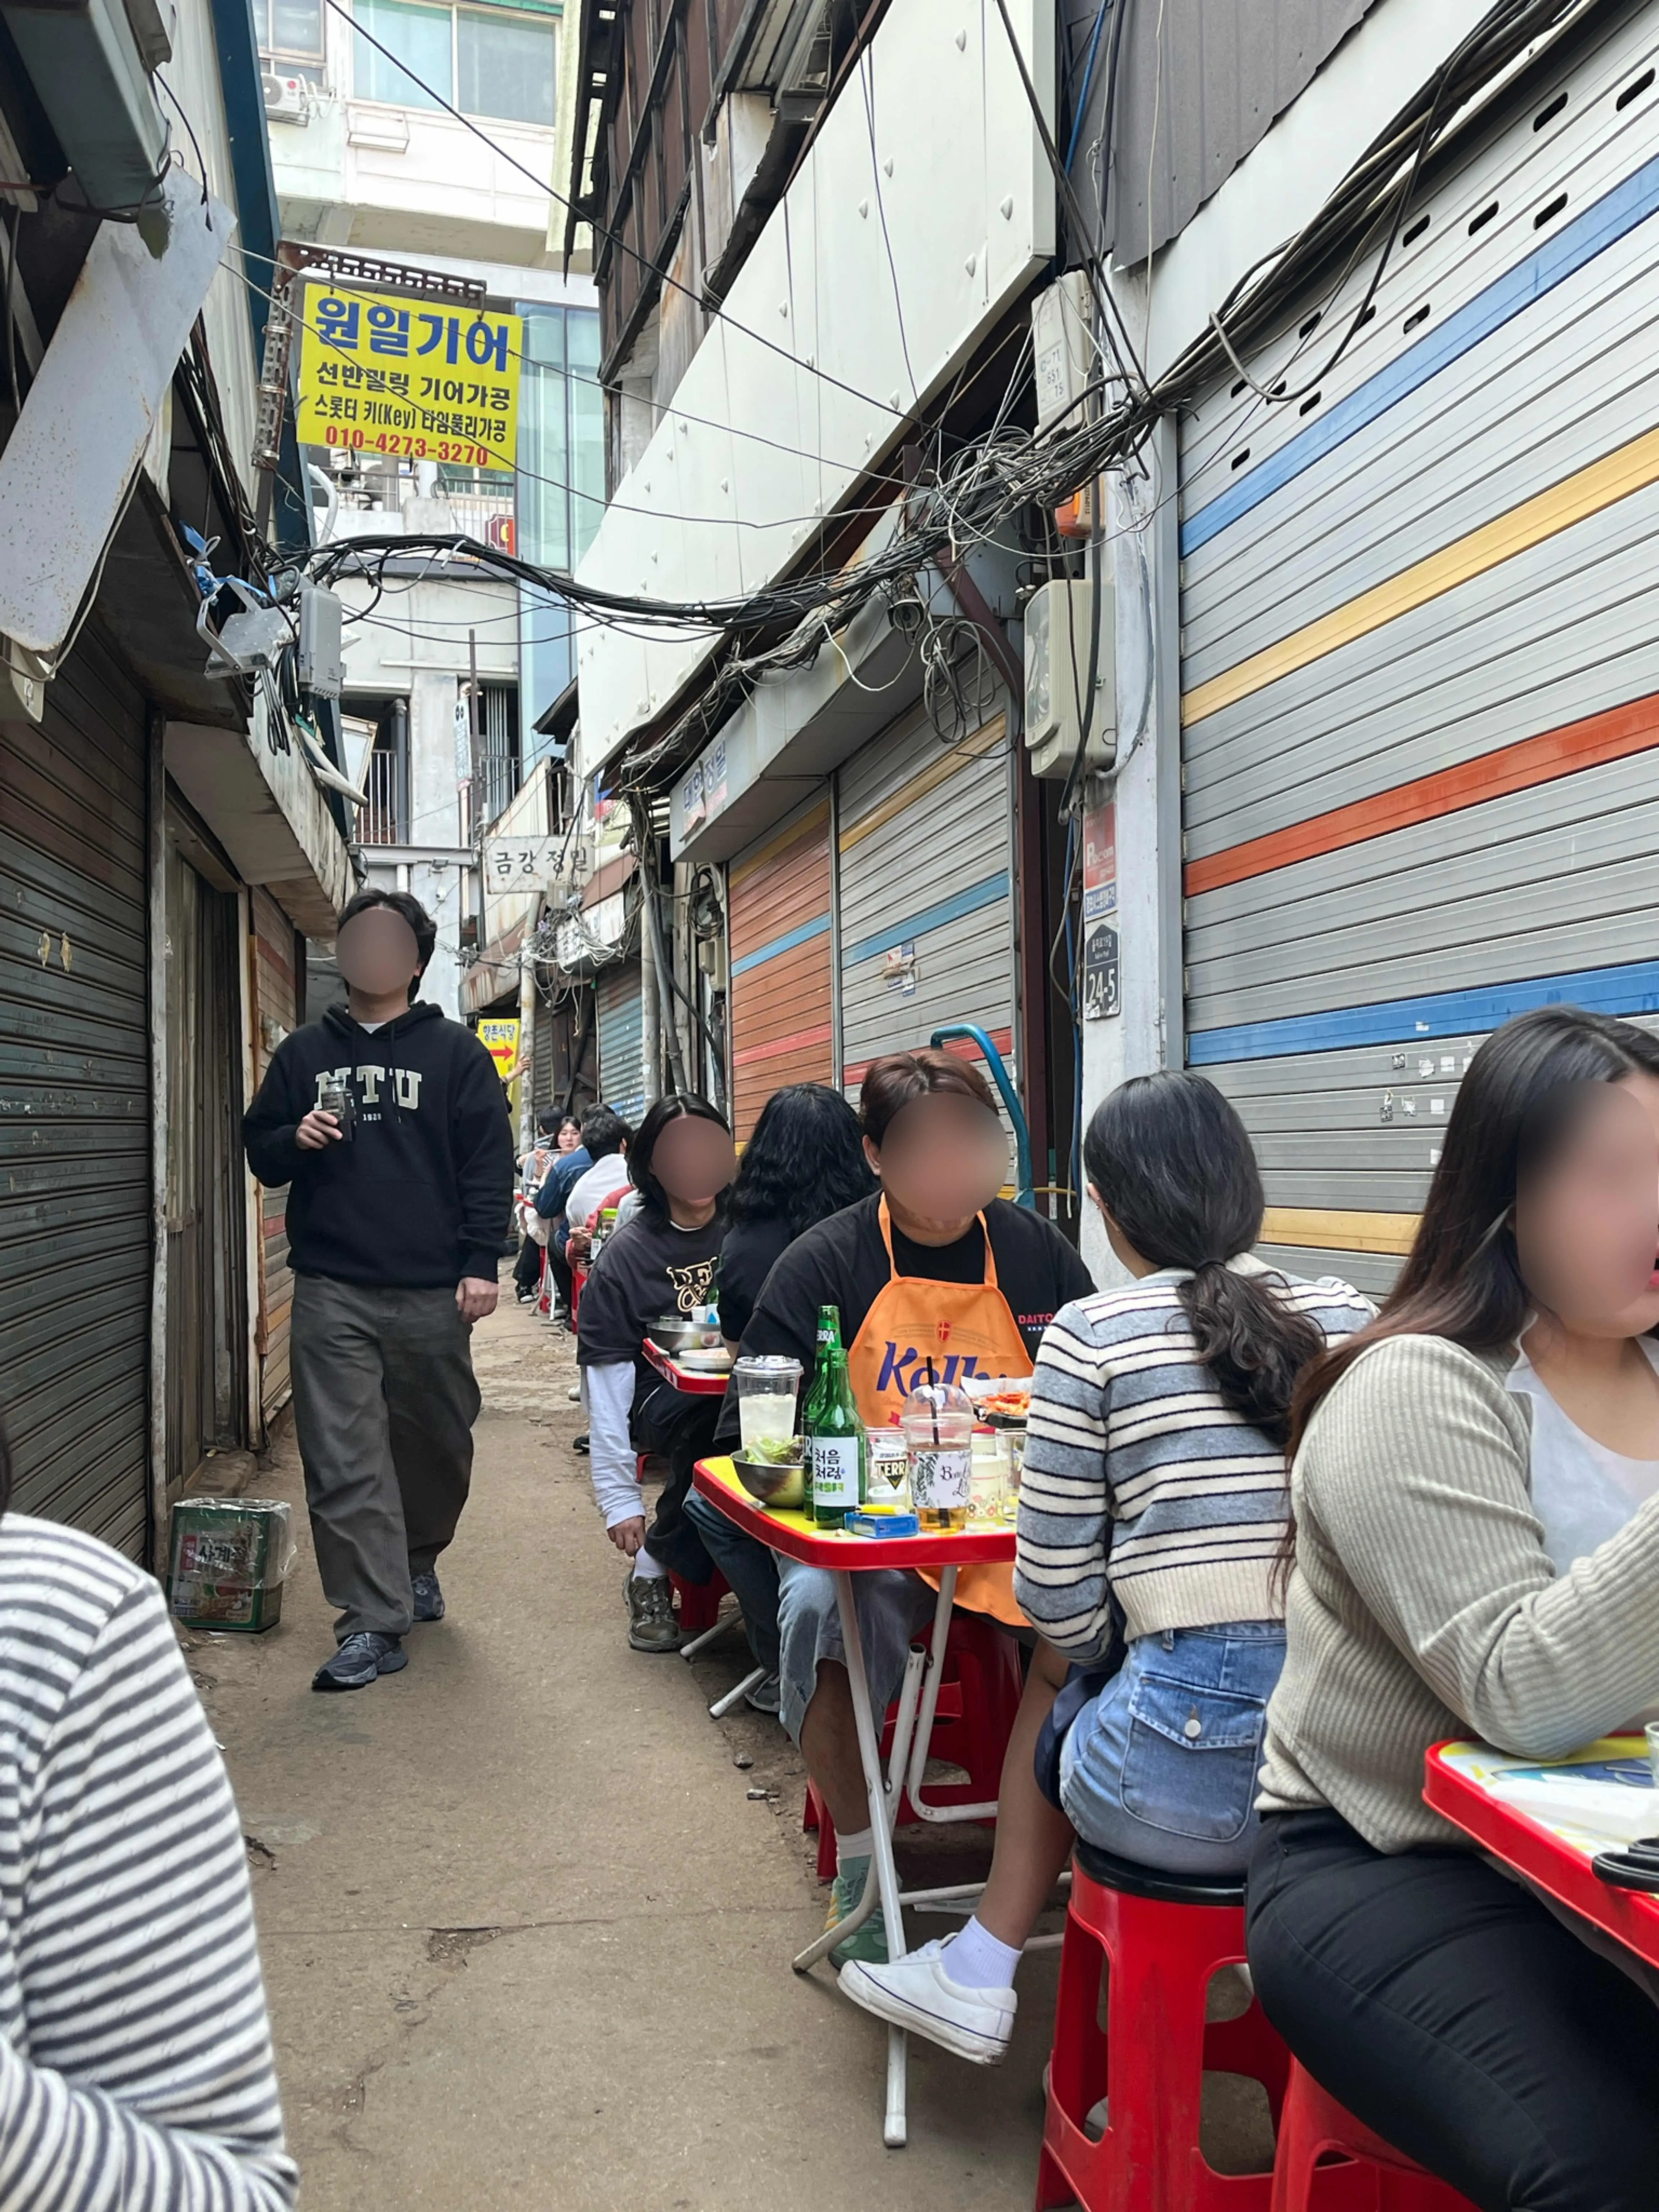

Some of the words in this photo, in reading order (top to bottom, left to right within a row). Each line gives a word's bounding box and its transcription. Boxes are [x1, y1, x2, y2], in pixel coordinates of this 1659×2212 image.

[315, 298, 508, 372] 원일기어
[420, 377, 510, 411] 기어가공
[314, 394, 357, 421] 스롯터
[364, 400, 416, 430] 키(Key)
[422, 410, 506, 443] 타임풀리가공
[325, 426, 488, 466] 010-4273-3270
[1089, 968, 1115, 1005] 24-5
[815, 1447, 841, 1465] 처음
